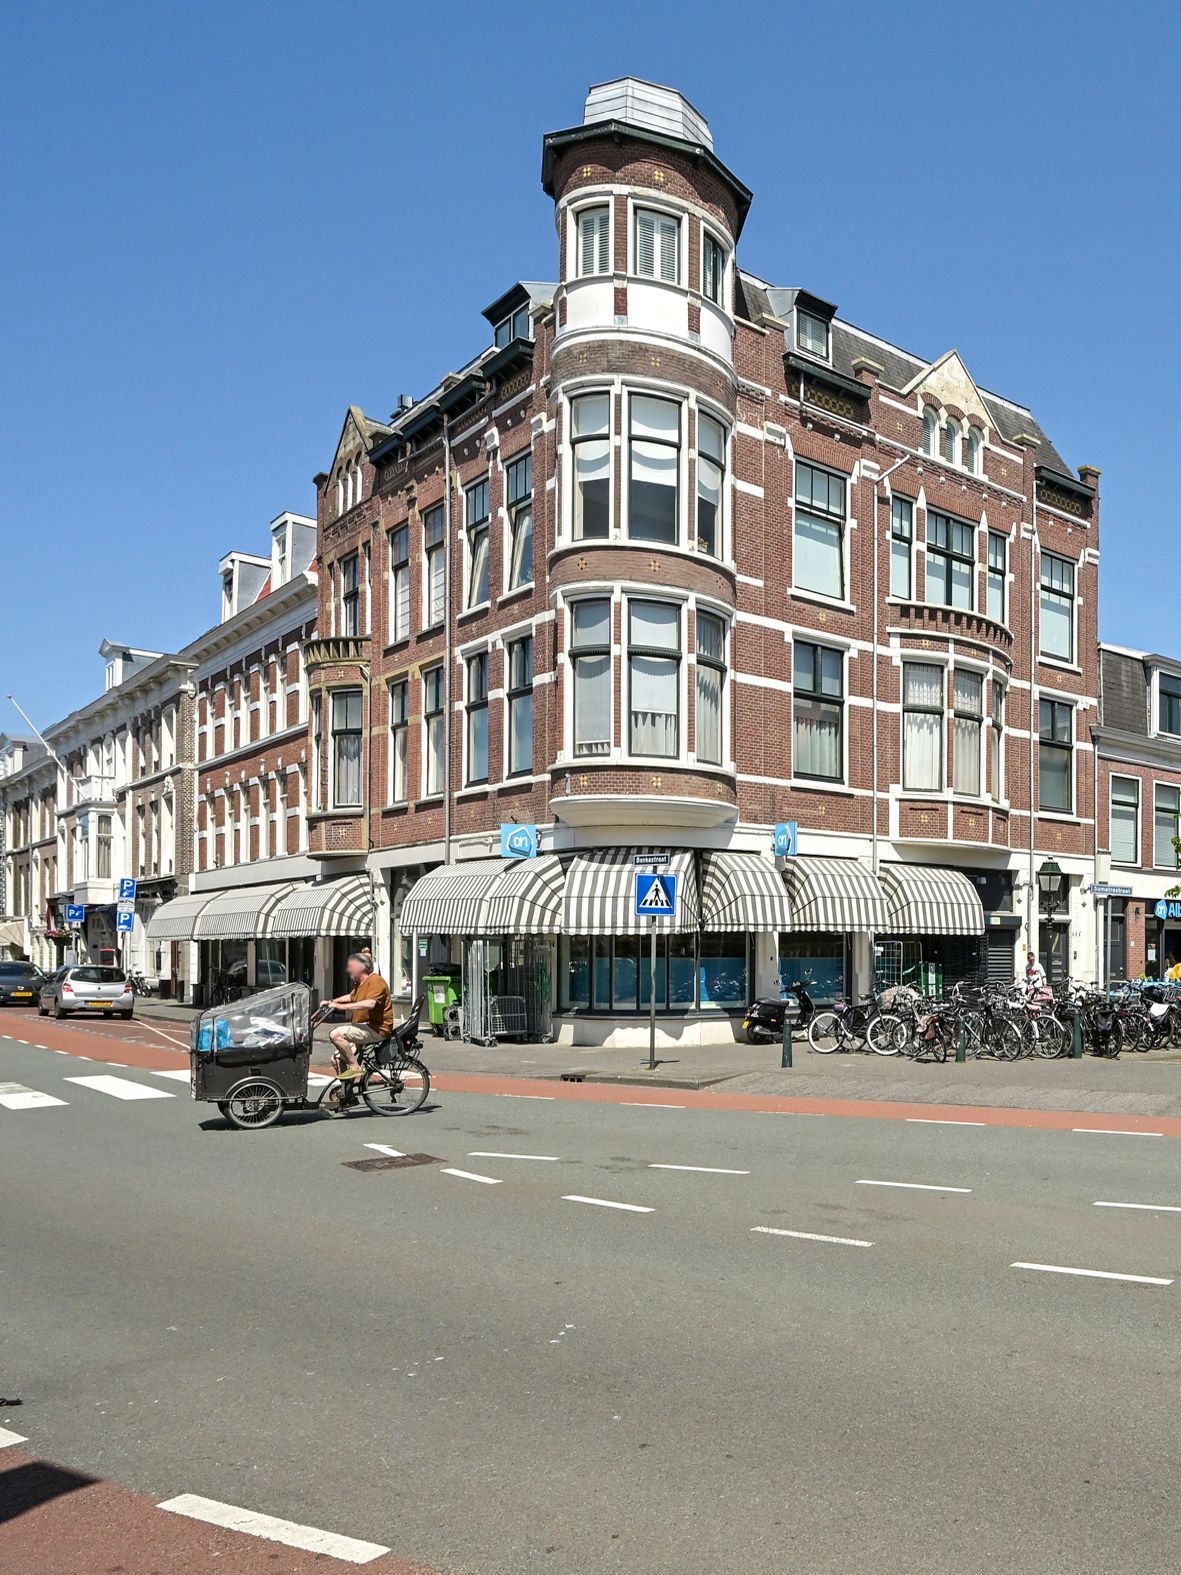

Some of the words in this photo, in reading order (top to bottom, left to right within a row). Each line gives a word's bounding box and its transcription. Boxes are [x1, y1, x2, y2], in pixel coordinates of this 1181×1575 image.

[123, 880, 133, 890] P
[69, 909, 75, 917] P
[120, 913, 130, 923] P
